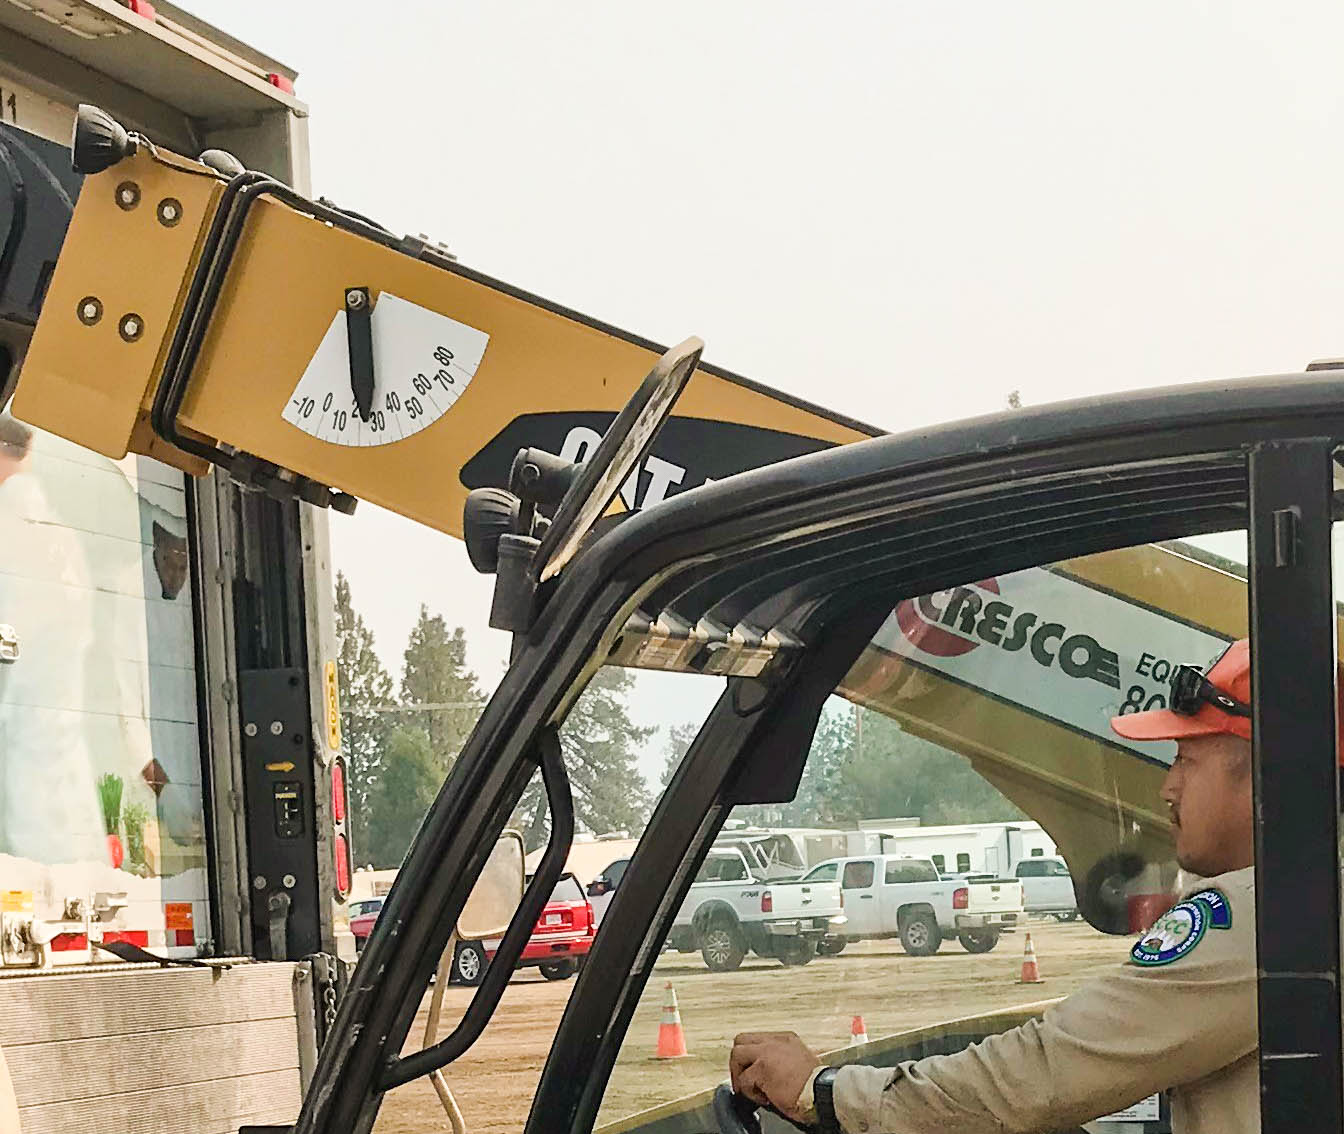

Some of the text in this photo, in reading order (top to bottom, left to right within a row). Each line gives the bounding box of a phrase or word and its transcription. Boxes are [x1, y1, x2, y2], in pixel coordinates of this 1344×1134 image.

[433, 346, 455, 367] 80
[412, 373, 432, 396] 60
[433, 369, 455, 392] 70
[293, 396, 315, 419] -10
[322, 392, 333, 413] 0
[385, 392, 401, 413] 40
[404, 397, 423, 419] 50
[332, 411, 347, 431] 10
[370, 411, 386, 432] 30
[916, 585, 1121, 690] CRESCO
